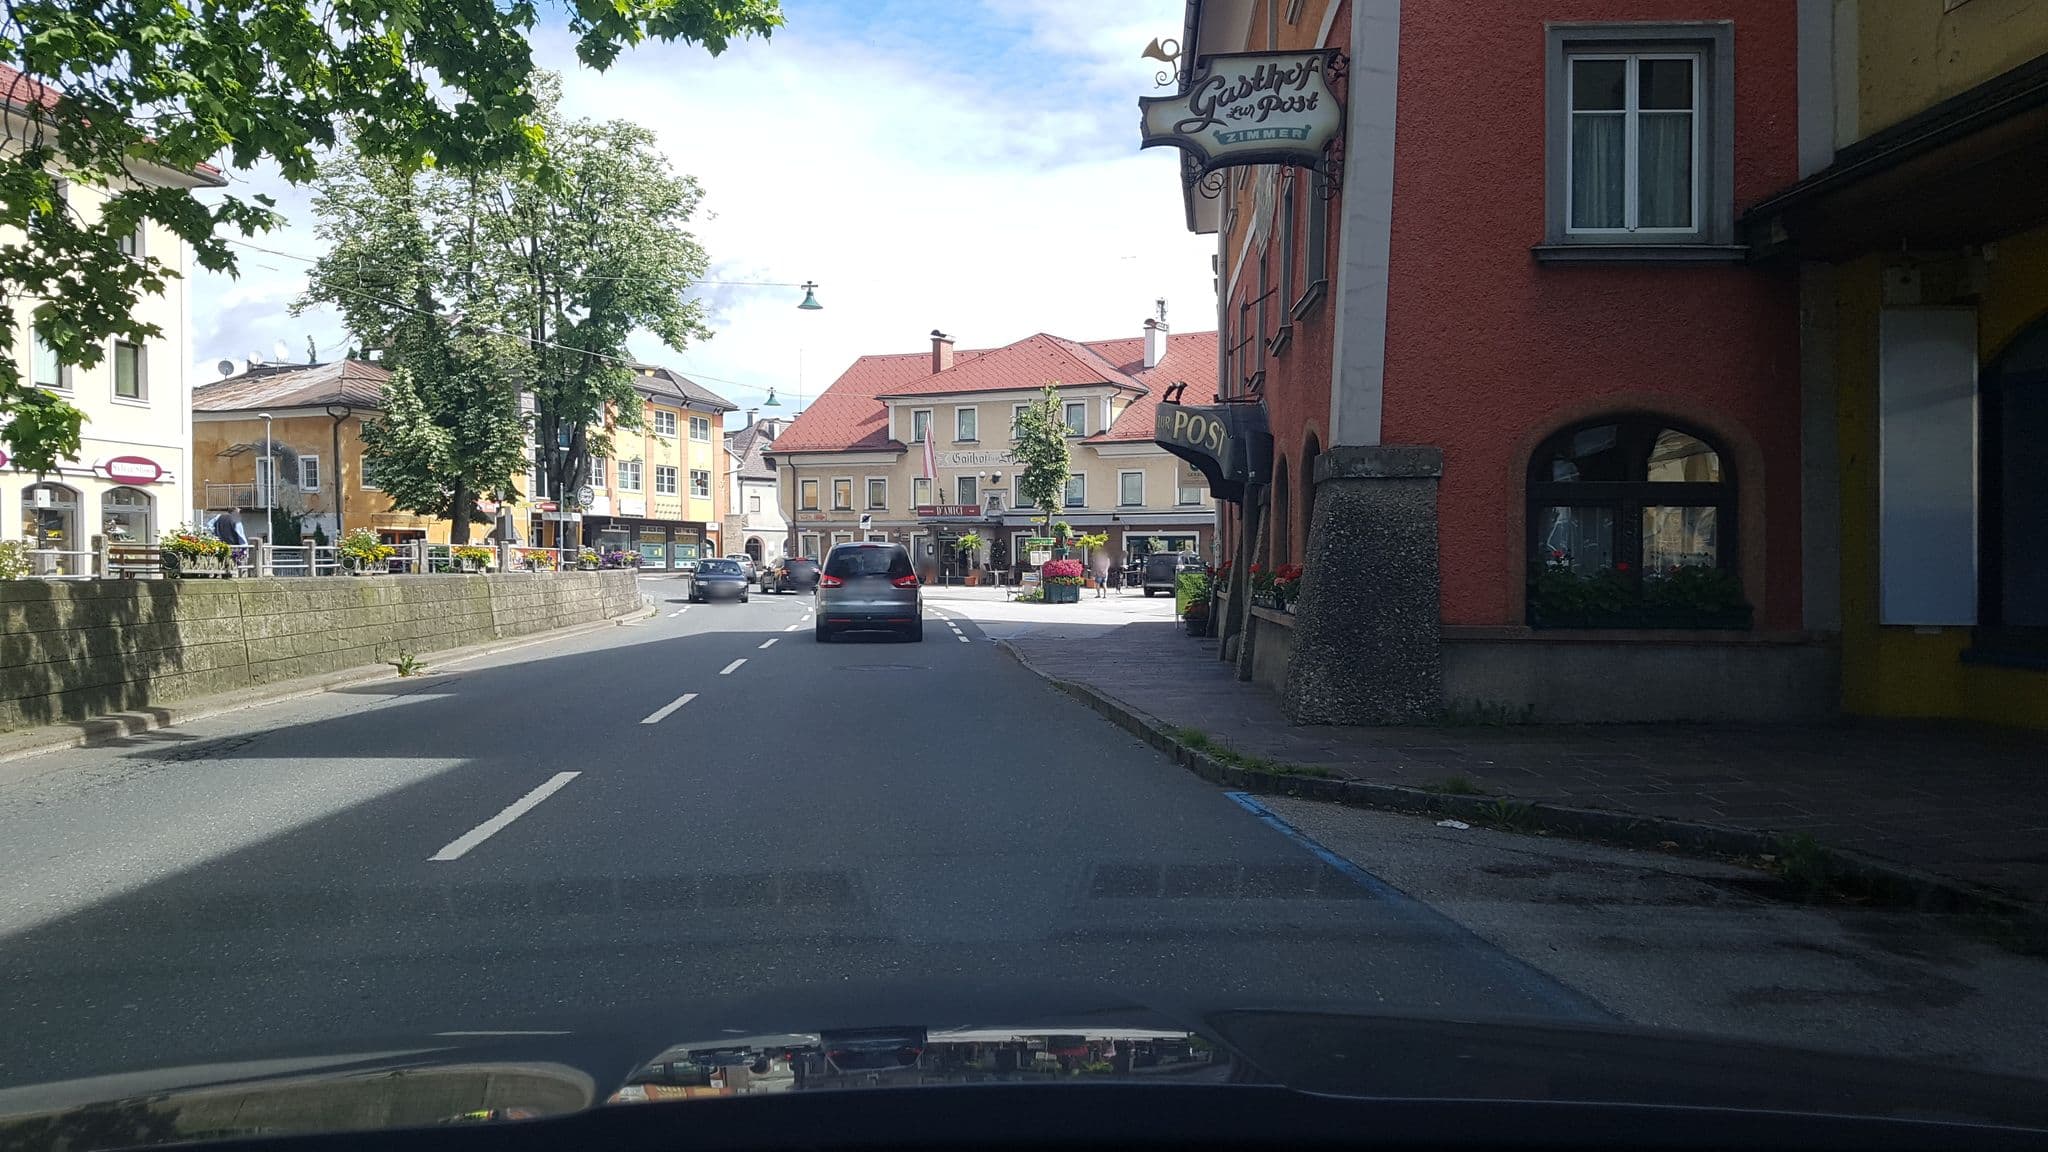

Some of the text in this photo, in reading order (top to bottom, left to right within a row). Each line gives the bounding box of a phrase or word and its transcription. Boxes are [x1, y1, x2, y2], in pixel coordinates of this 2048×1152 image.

[1173, 56, 1319, 134] Gasthof
[1226, 91, 1319, 123] zur Post
[1226, 129, 1303, 142] ZIMMER
[1172, 410, 1227, 457] POST
[936, 506, 963, 516] D'AMICI
